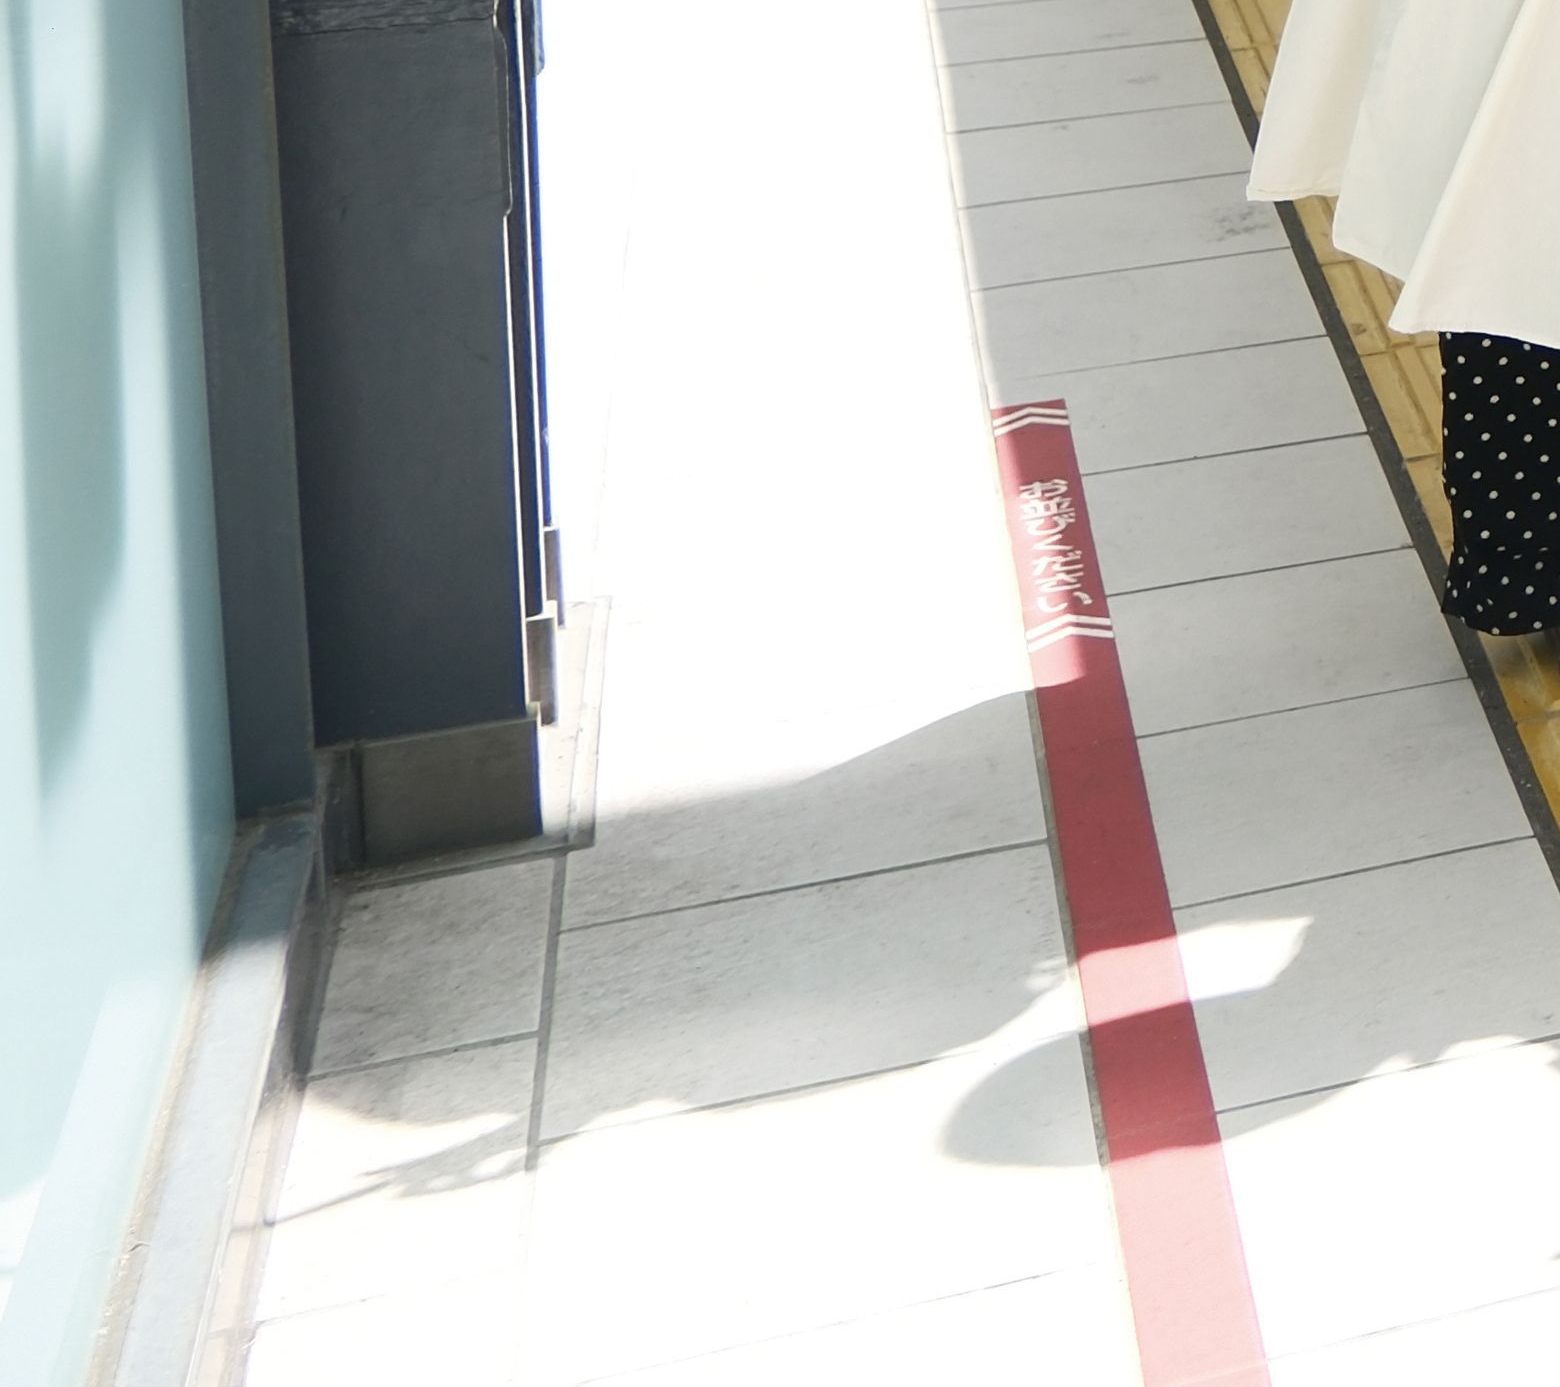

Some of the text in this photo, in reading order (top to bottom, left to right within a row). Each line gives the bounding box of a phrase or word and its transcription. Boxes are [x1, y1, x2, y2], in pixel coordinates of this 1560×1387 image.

[1019, 478, 1092, 613] お並びください
